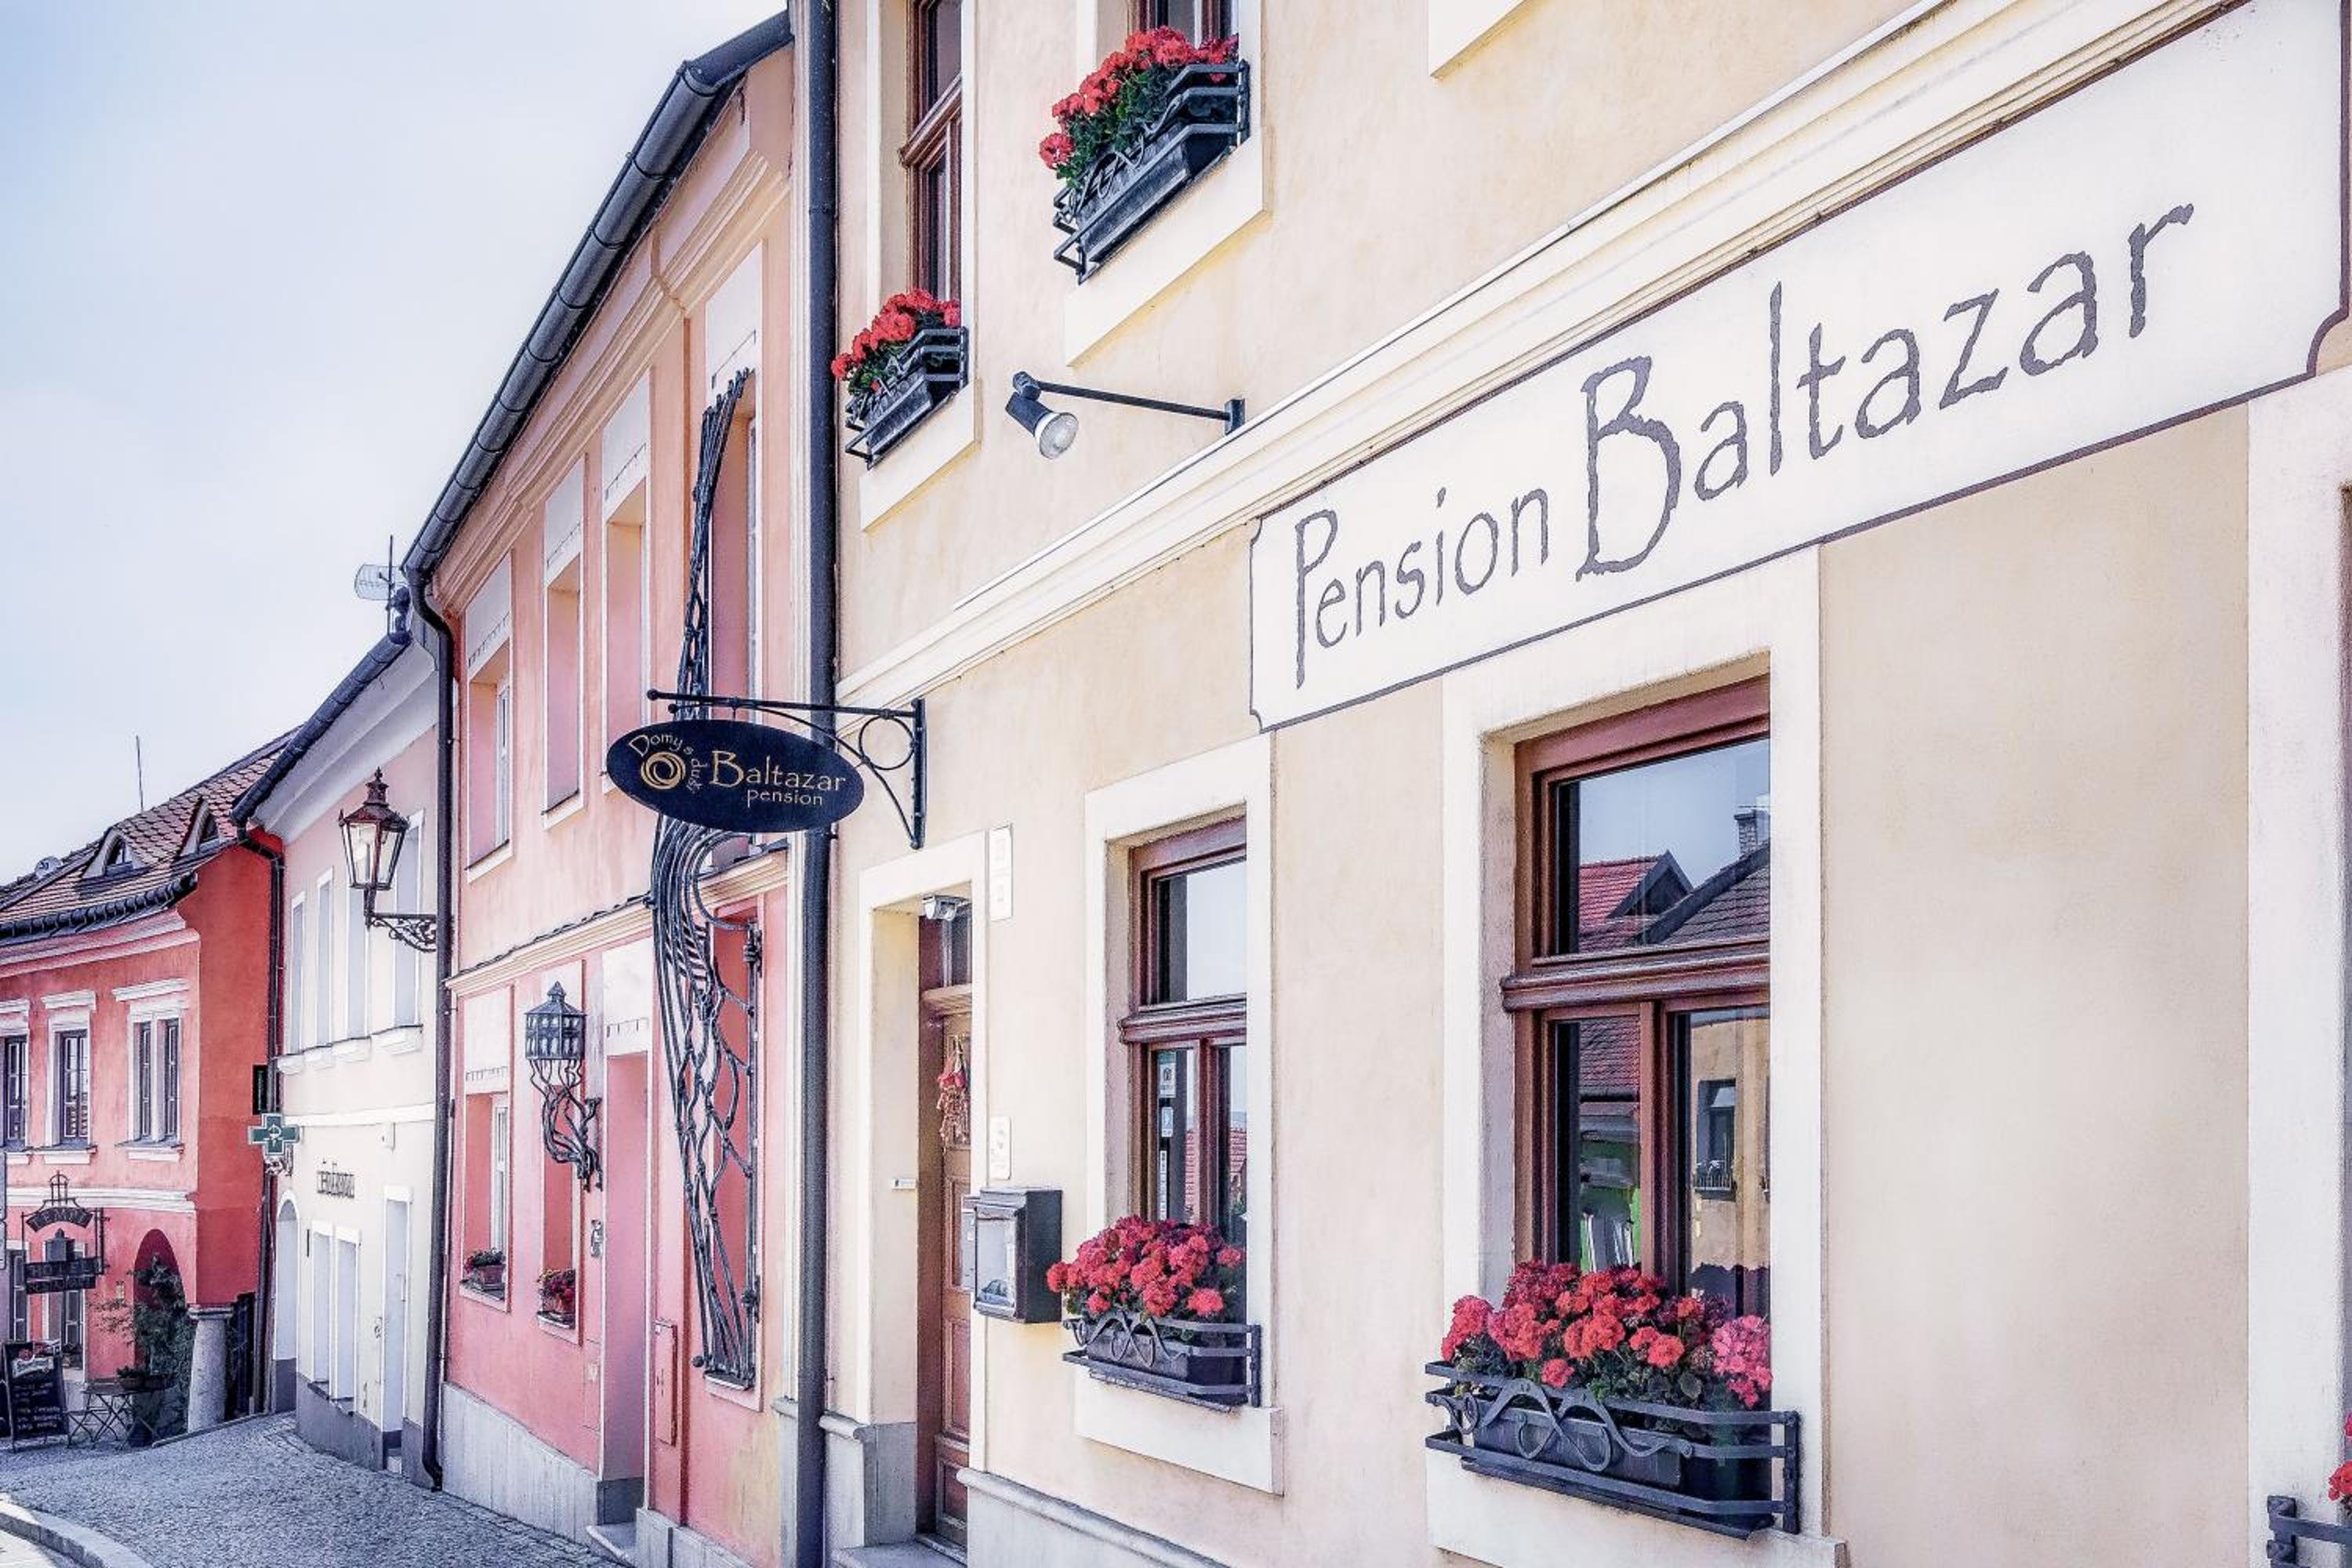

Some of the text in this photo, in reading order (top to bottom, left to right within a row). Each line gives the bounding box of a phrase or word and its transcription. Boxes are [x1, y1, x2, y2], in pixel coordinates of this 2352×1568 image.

[1294, 203, 2195, 689] Pension Baltazar
[628, 733, 683, 757] Domy
[708, 750, 847, 793] Baltazar
[746, 789, 823, 808] pension
